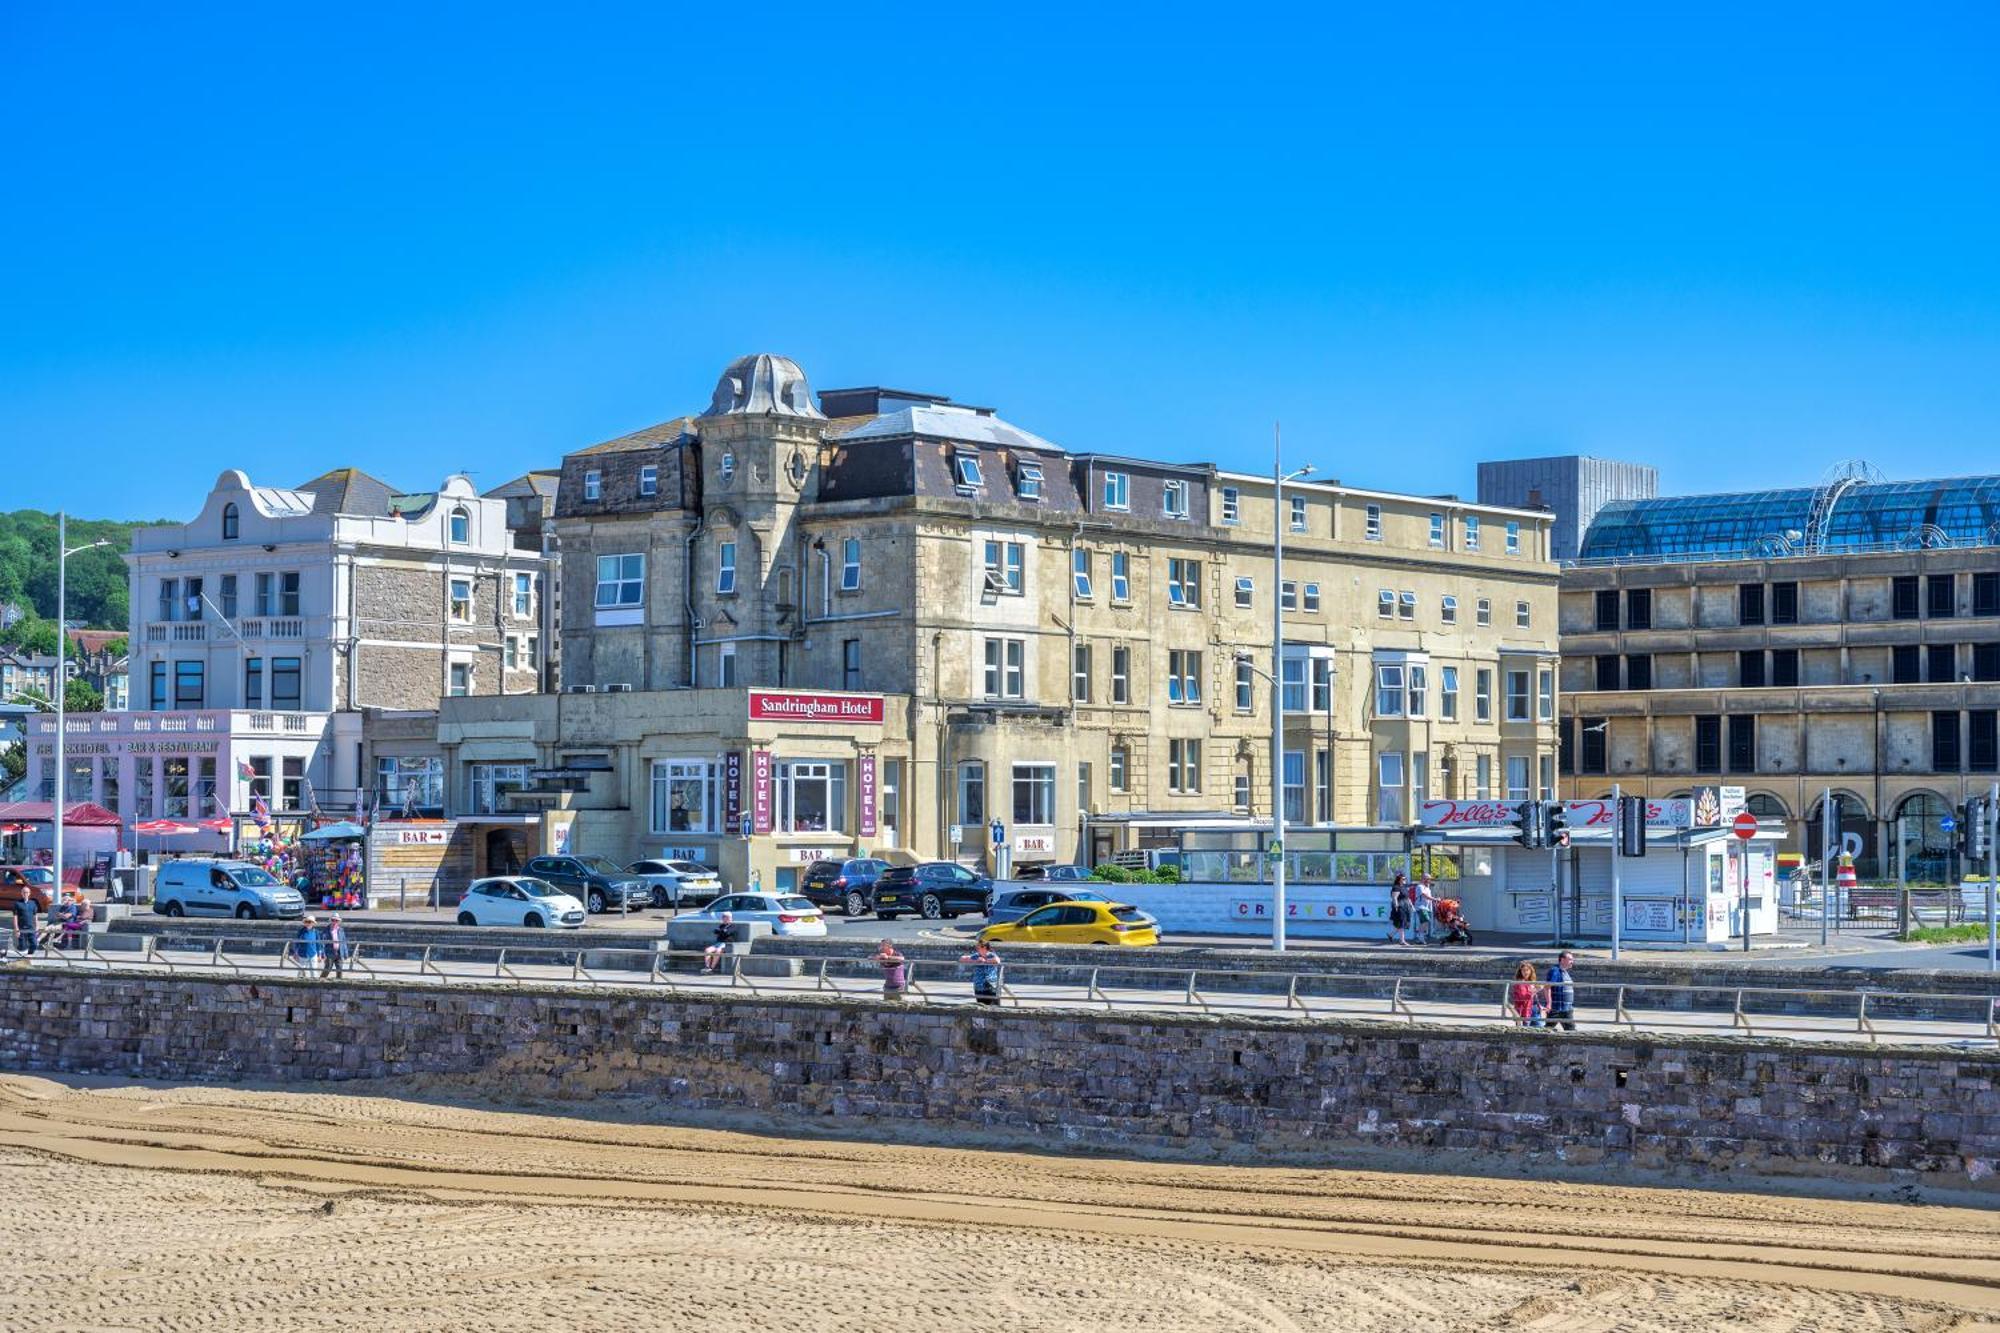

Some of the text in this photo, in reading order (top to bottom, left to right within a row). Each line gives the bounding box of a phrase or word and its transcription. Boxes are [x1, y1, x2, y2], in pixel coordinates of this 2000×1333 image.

[761, 698, 872, 717] Sandringham Hotel
[728, 756, 739, 812] HOTEL
[757, 756, 768, 812] HOTEL
[863, 763, 873, 816] HOTEL
[402, 832, 428, 843] BAR
[1023, 839, 1045, 850] BAR
[672, 849, 697, 861] BAR
[800, 850, 823, 862] BAR
[1238, 904, 1386, 917] CRZY GOLF
